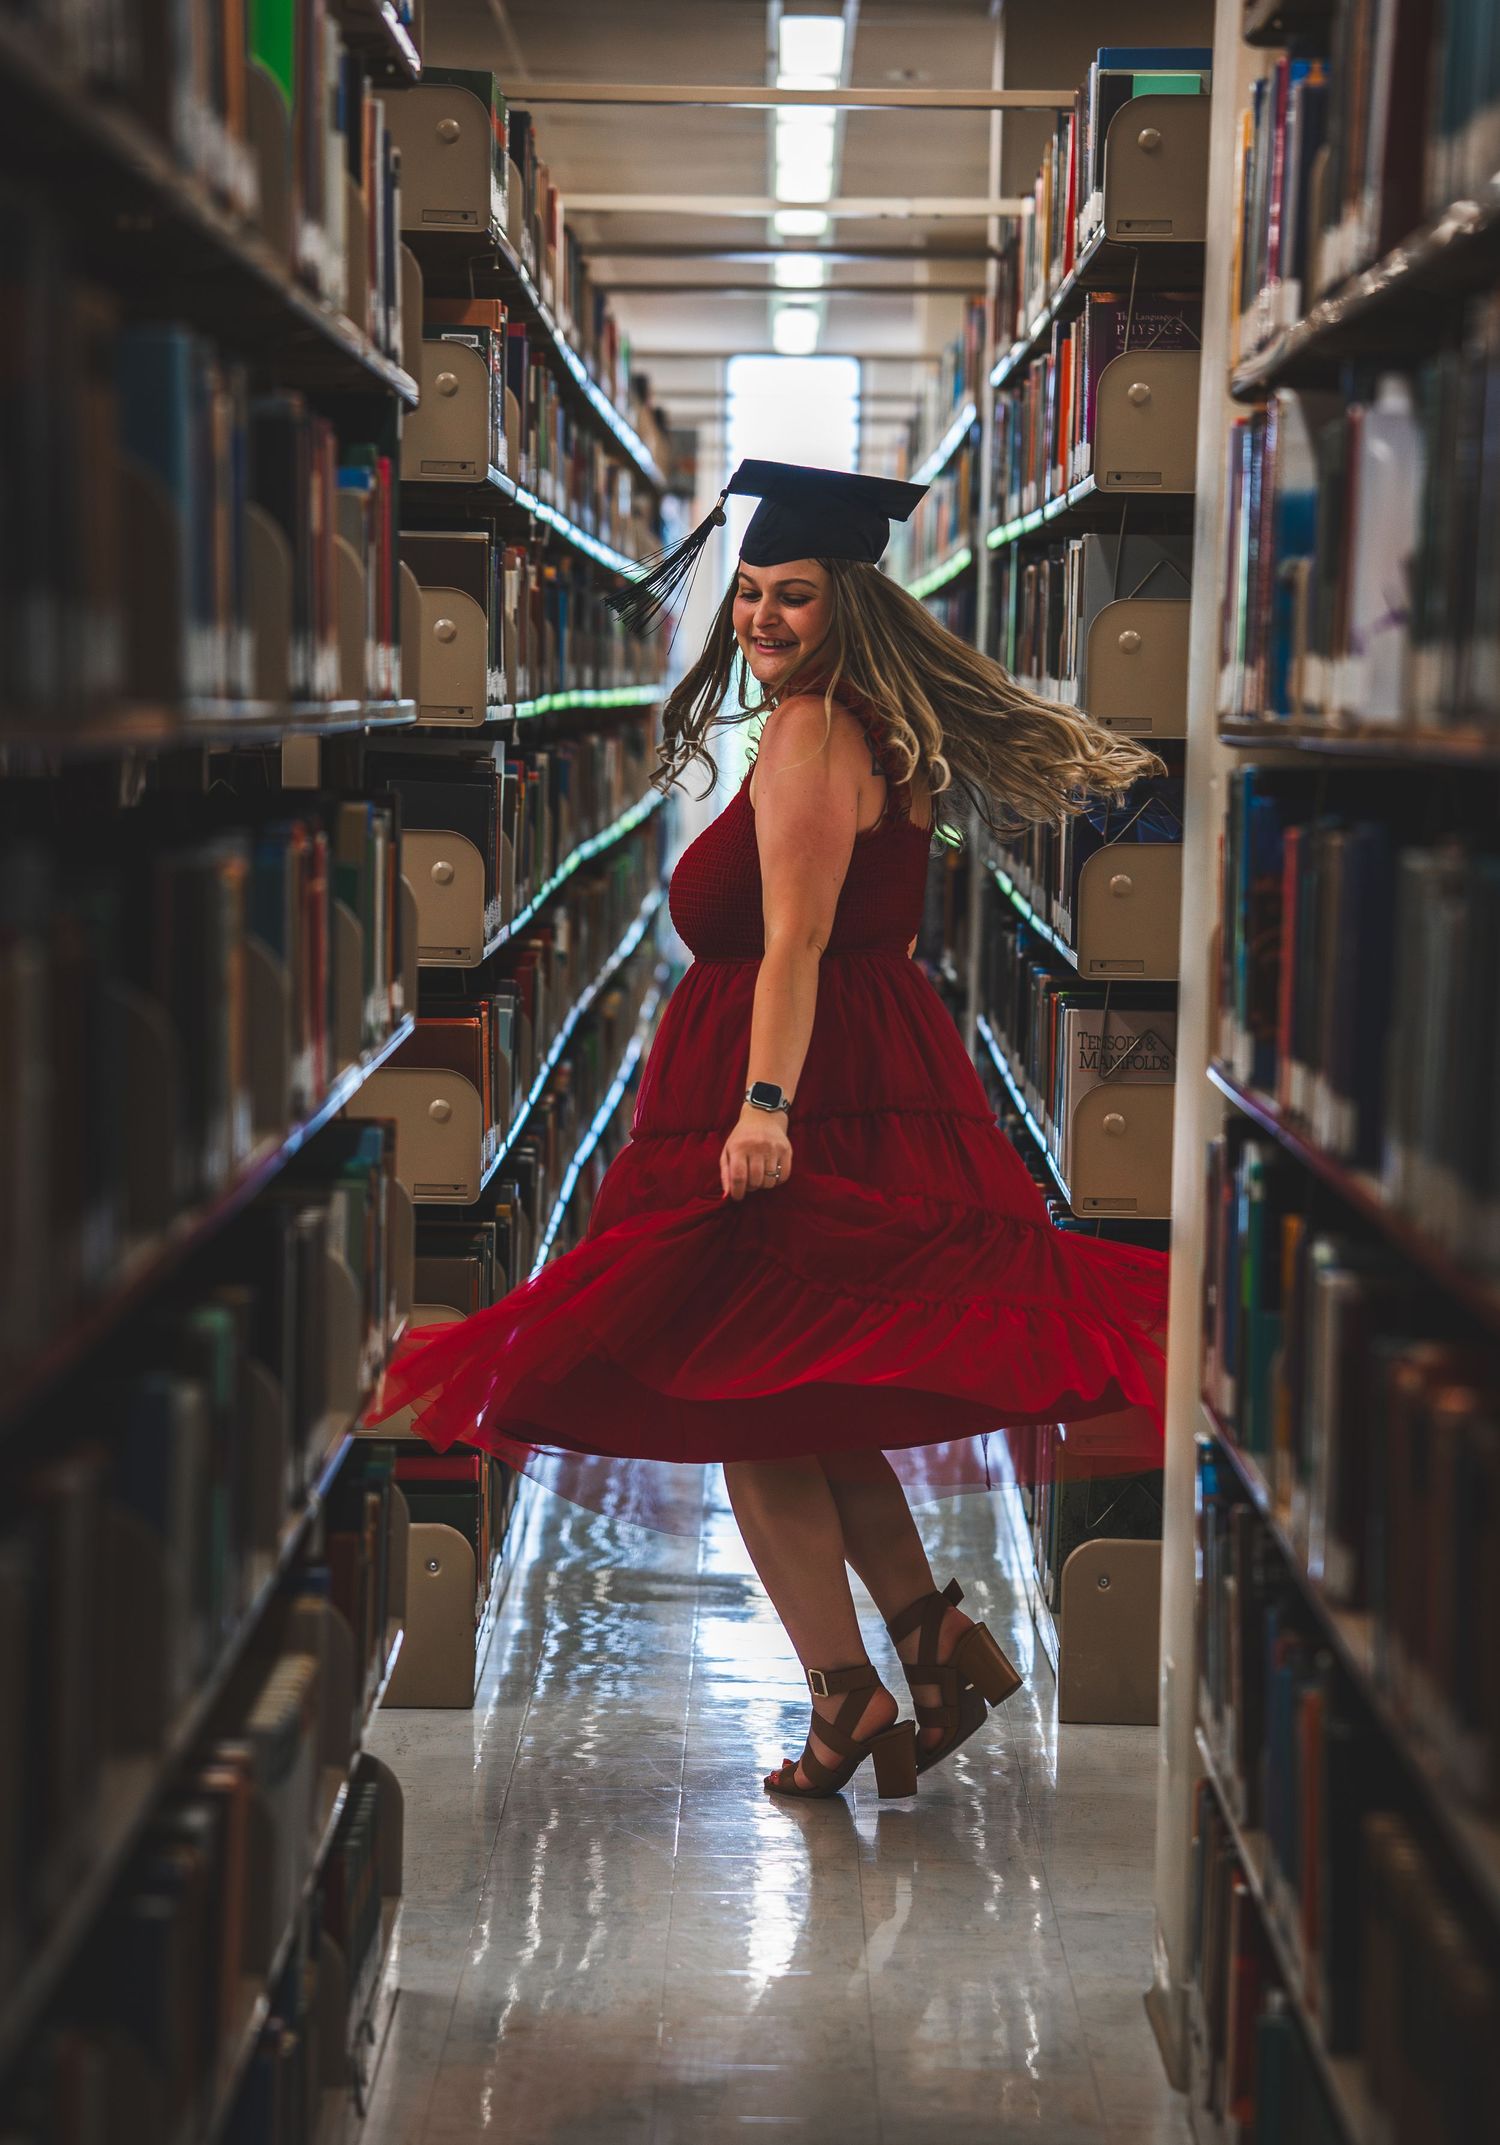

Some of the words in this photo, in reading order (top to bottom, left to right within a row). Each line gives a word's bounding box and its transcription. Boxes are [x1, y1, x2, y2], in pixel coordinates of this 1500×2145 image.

[1116, 312, 1132, 321] Th
[1145, 1035, 1157, 1051] &
[1078, 1051, 1170, 1071] MANIFOLDS
